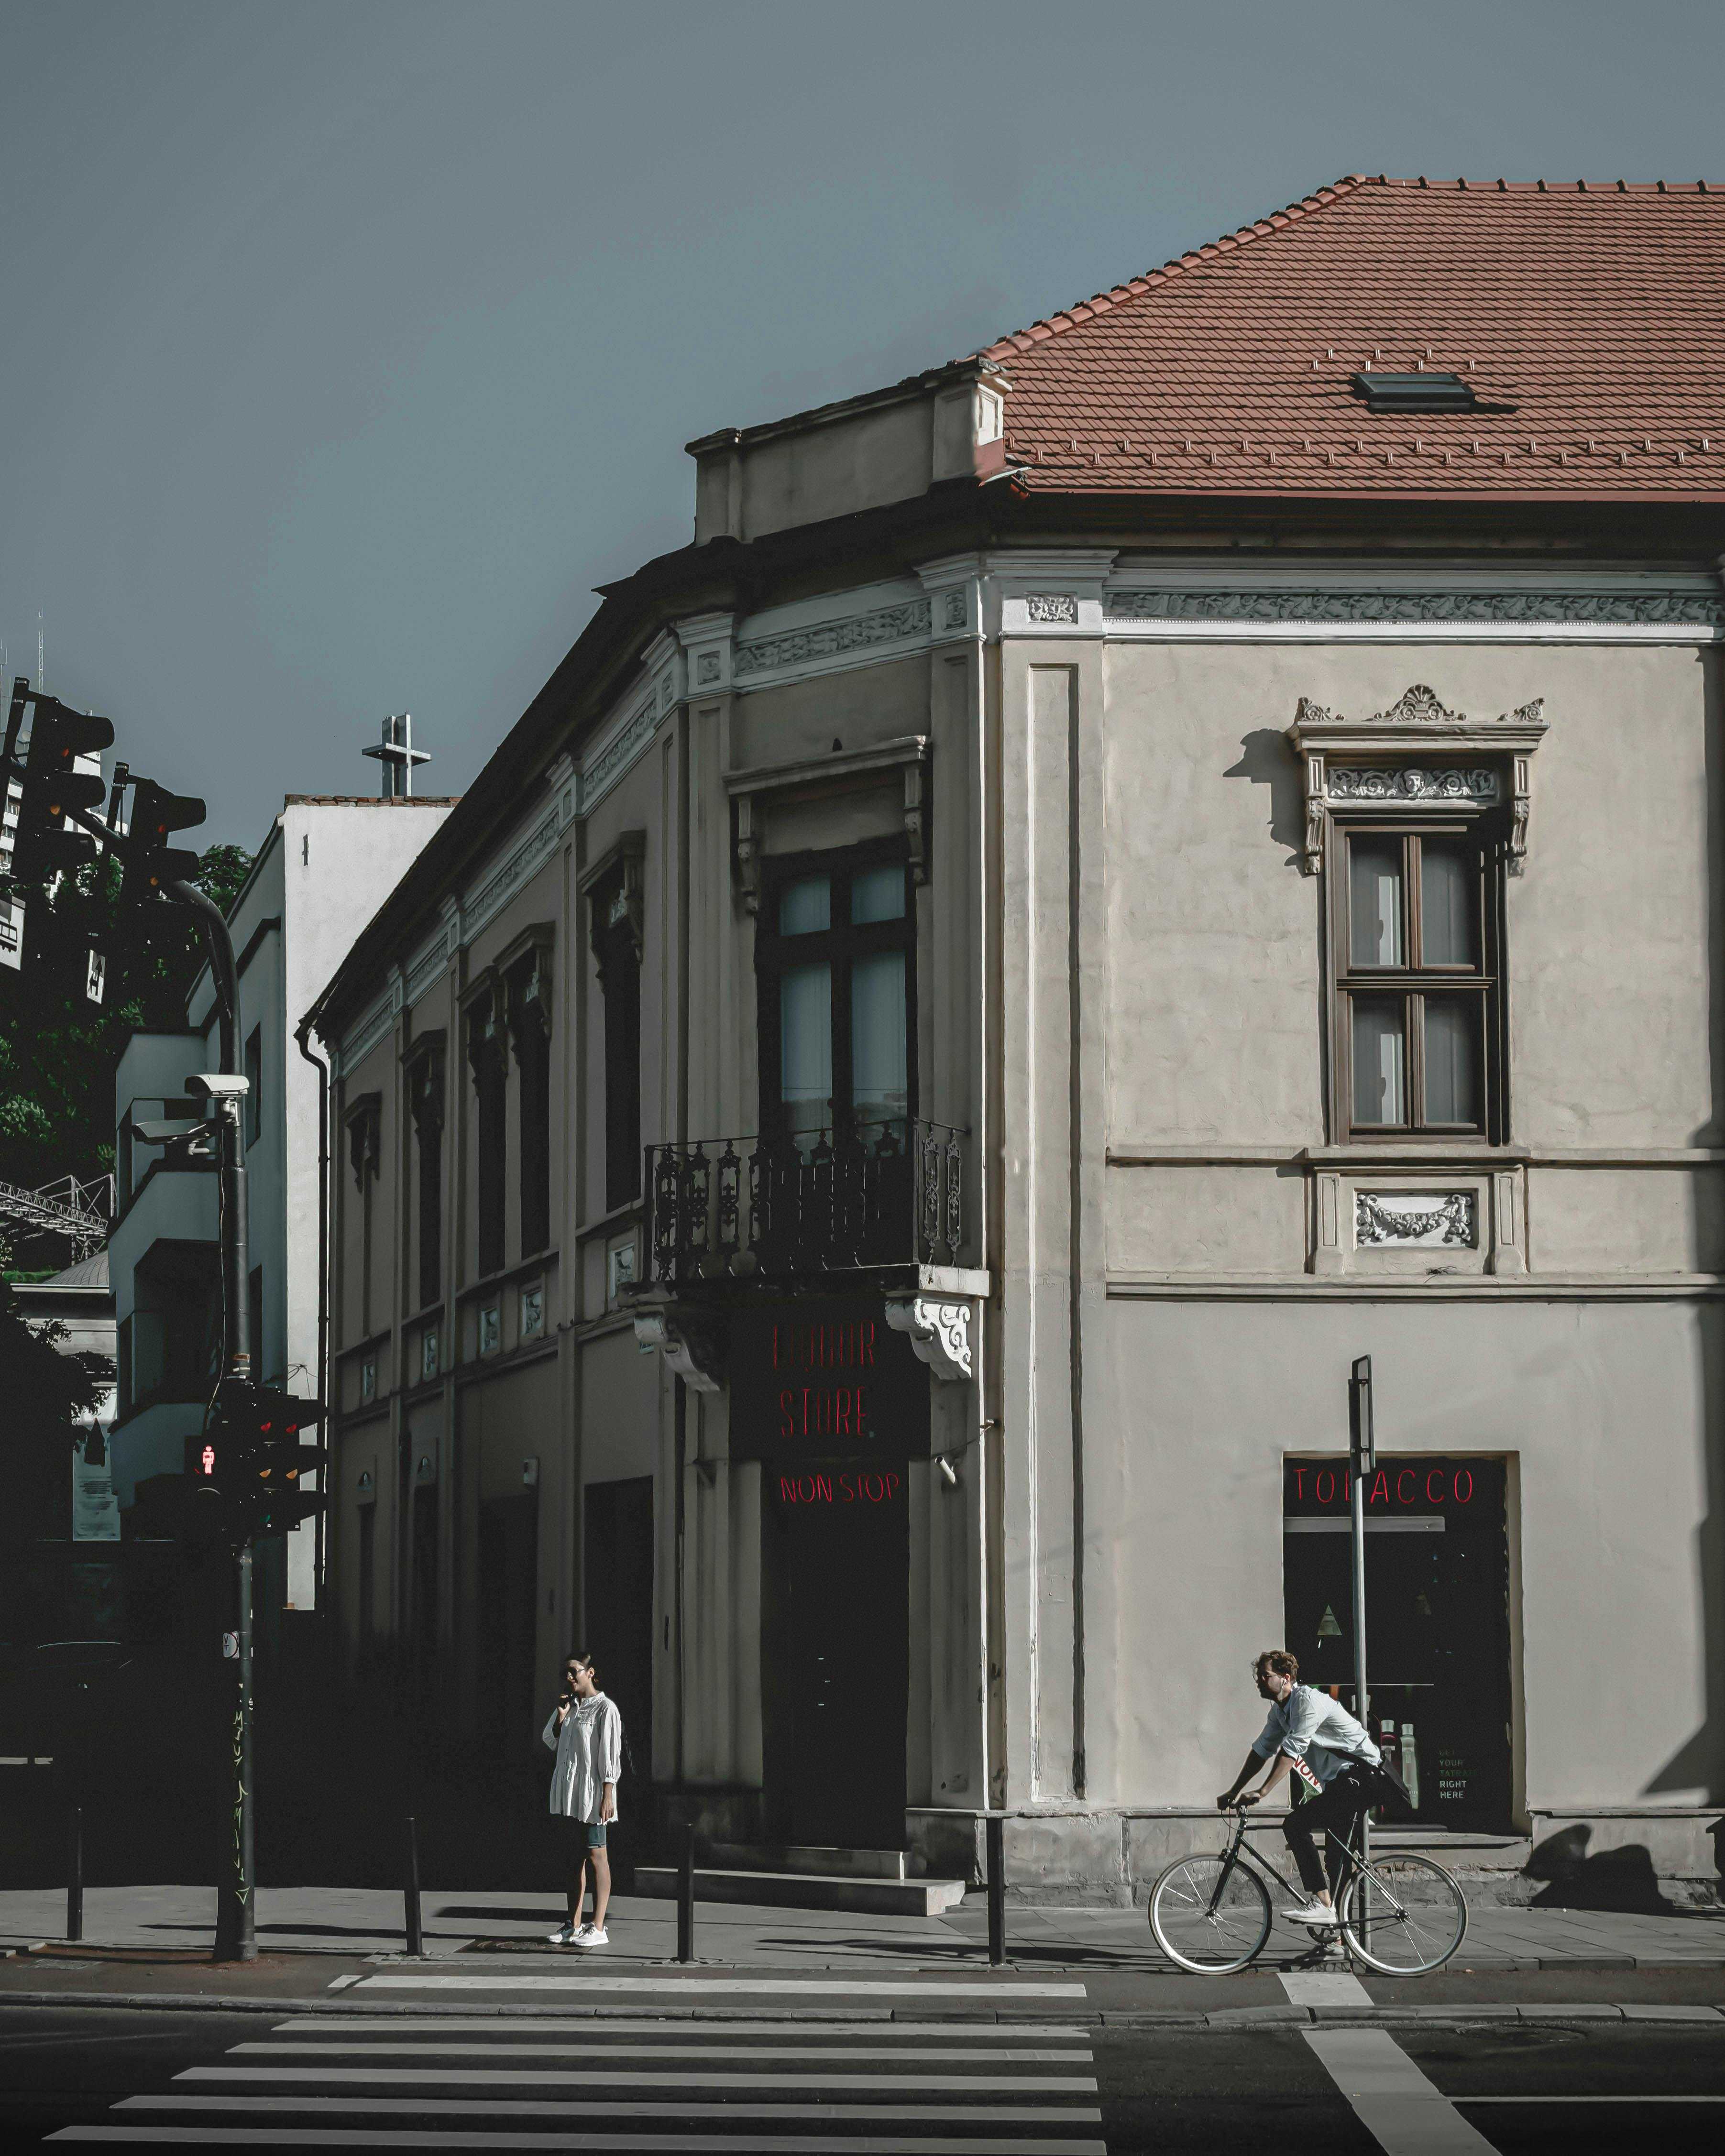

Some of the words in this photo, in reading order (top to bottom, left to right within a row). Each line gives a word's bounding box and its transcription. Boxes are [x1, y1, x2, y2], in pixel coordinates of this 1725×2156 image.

[780, 1386, 866, 1438] STORE
[780, 1473, 833, 1503] NON
[839, 1473, 900, 1503] STOP
